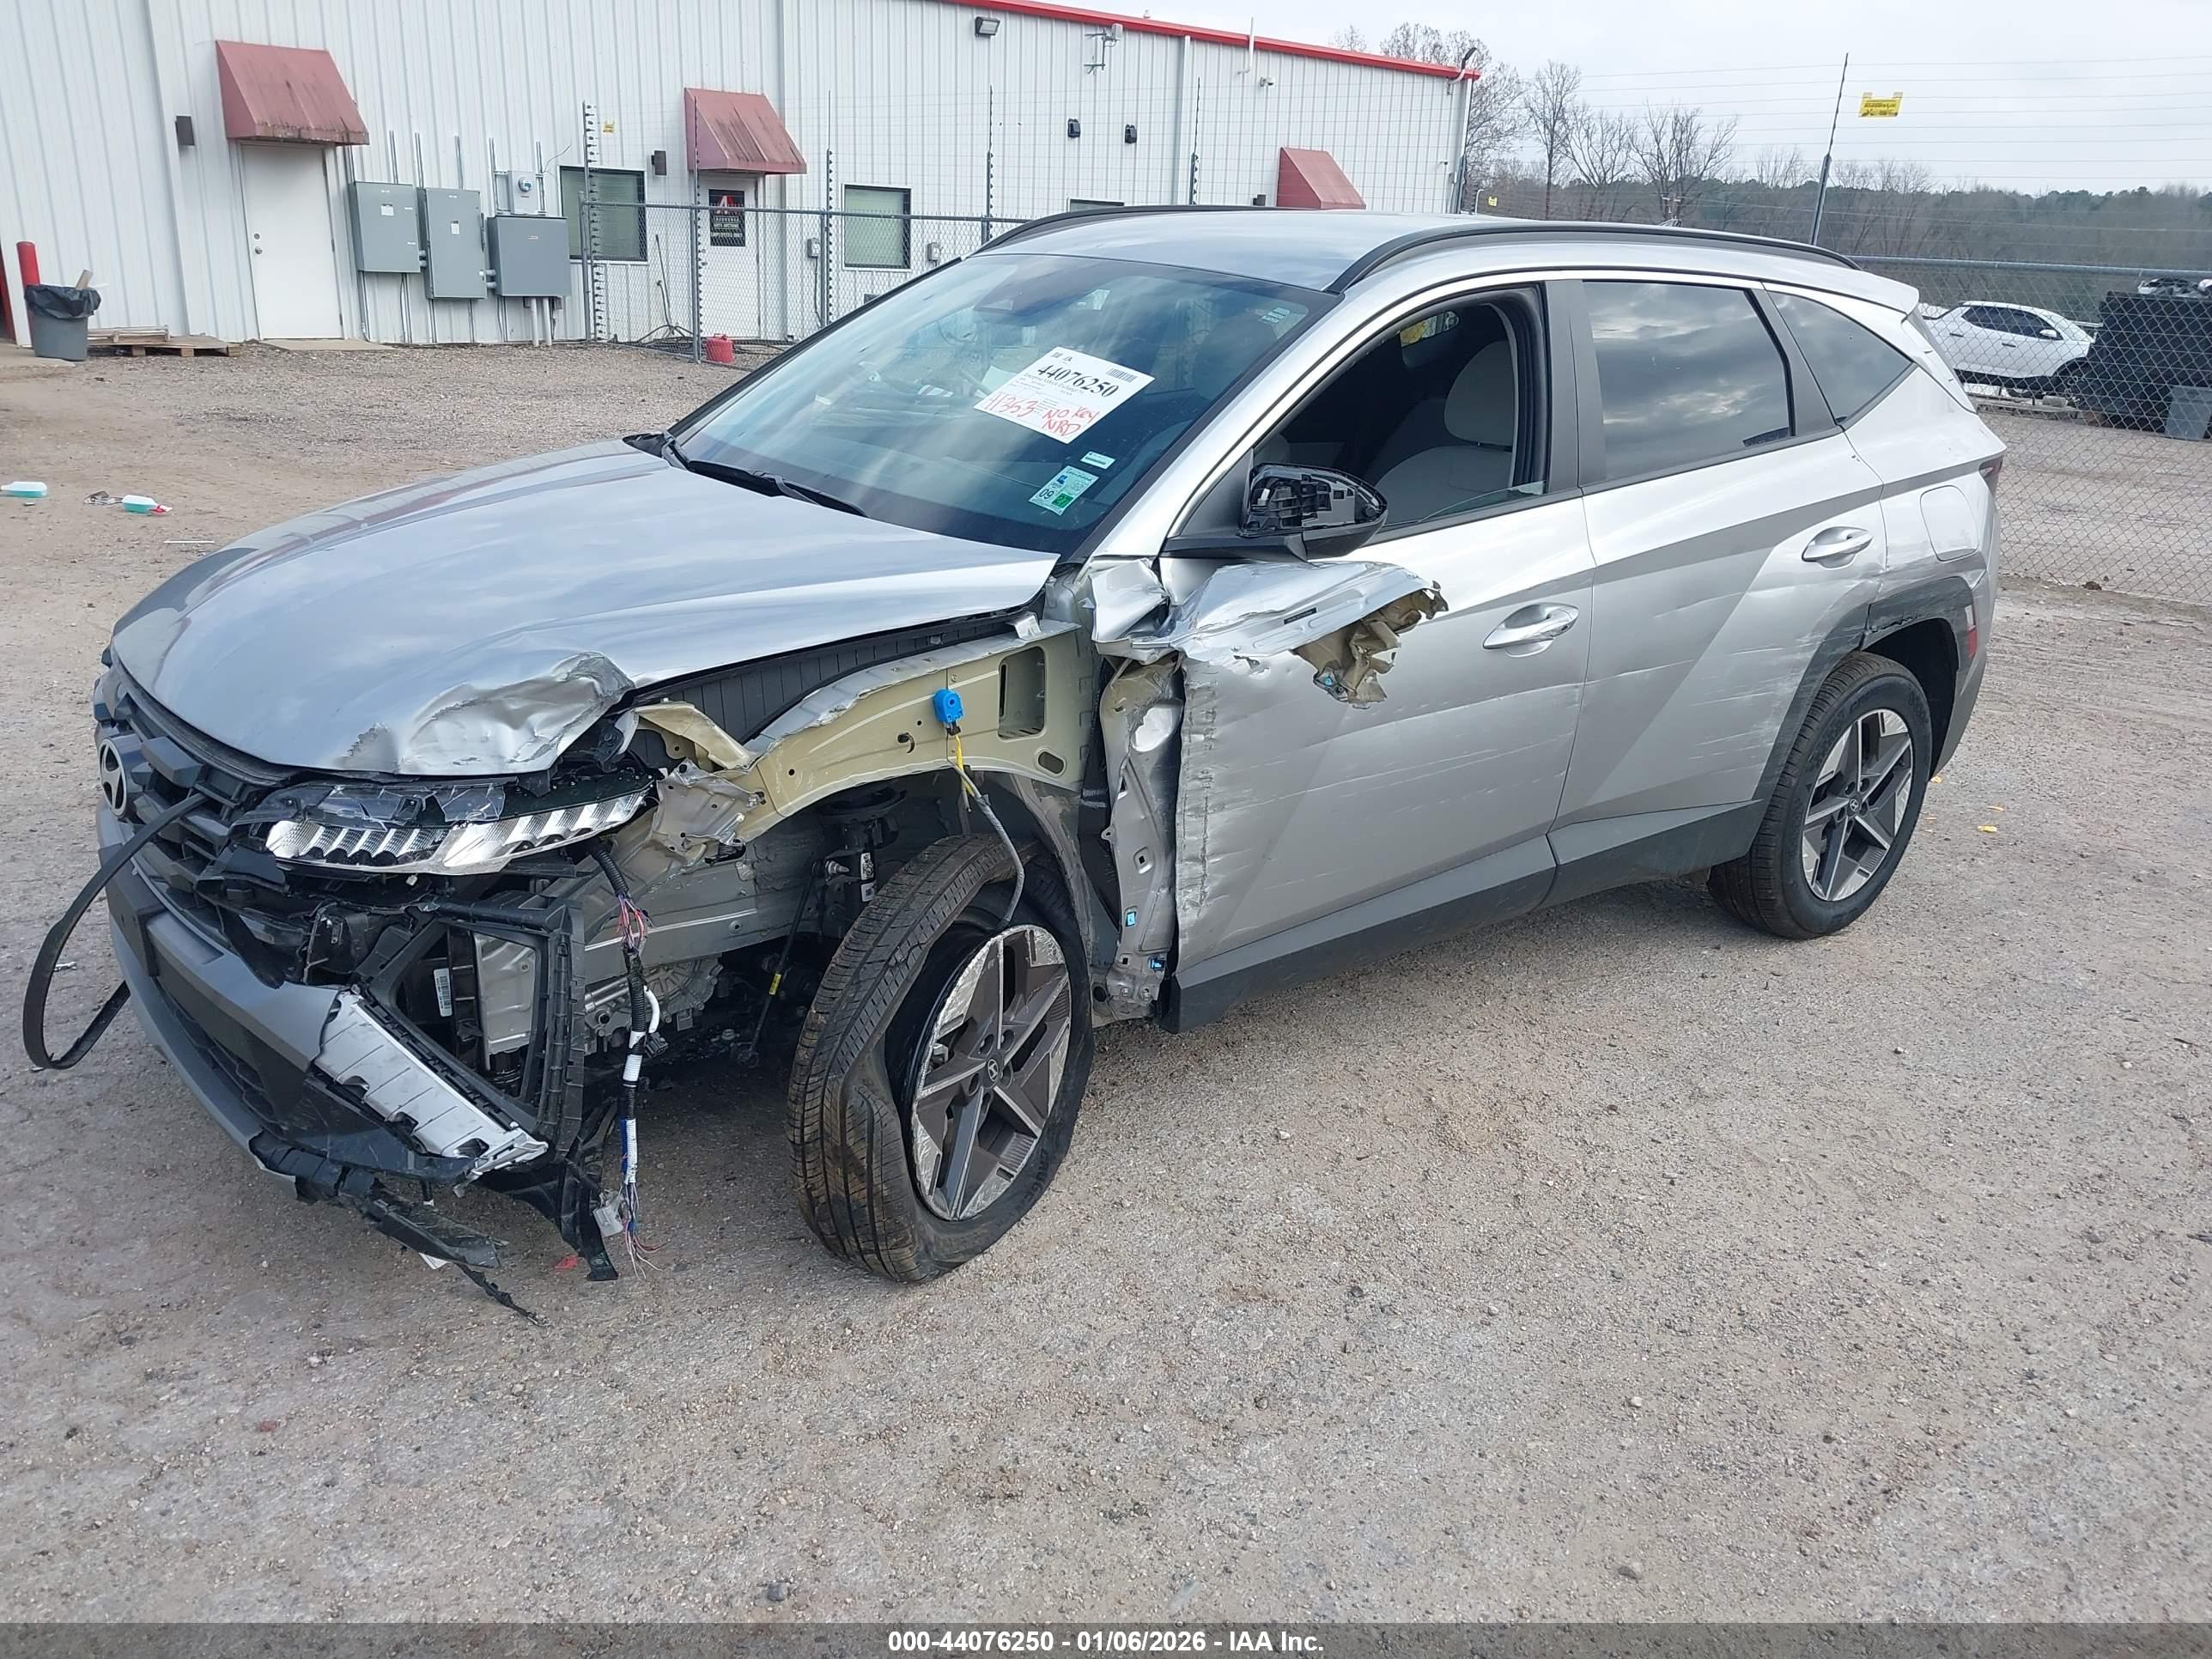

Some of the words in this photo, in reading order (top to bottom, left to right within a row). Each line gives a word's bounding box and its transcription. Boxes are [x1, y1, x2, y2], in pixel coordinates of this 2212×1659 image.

[1036, 364, 1119, 398] 44076250
[1042, 409, 1070, 419] NO
[1038, 489, 1054, 500] 09
[1054, 495, 1072, 506] 27
